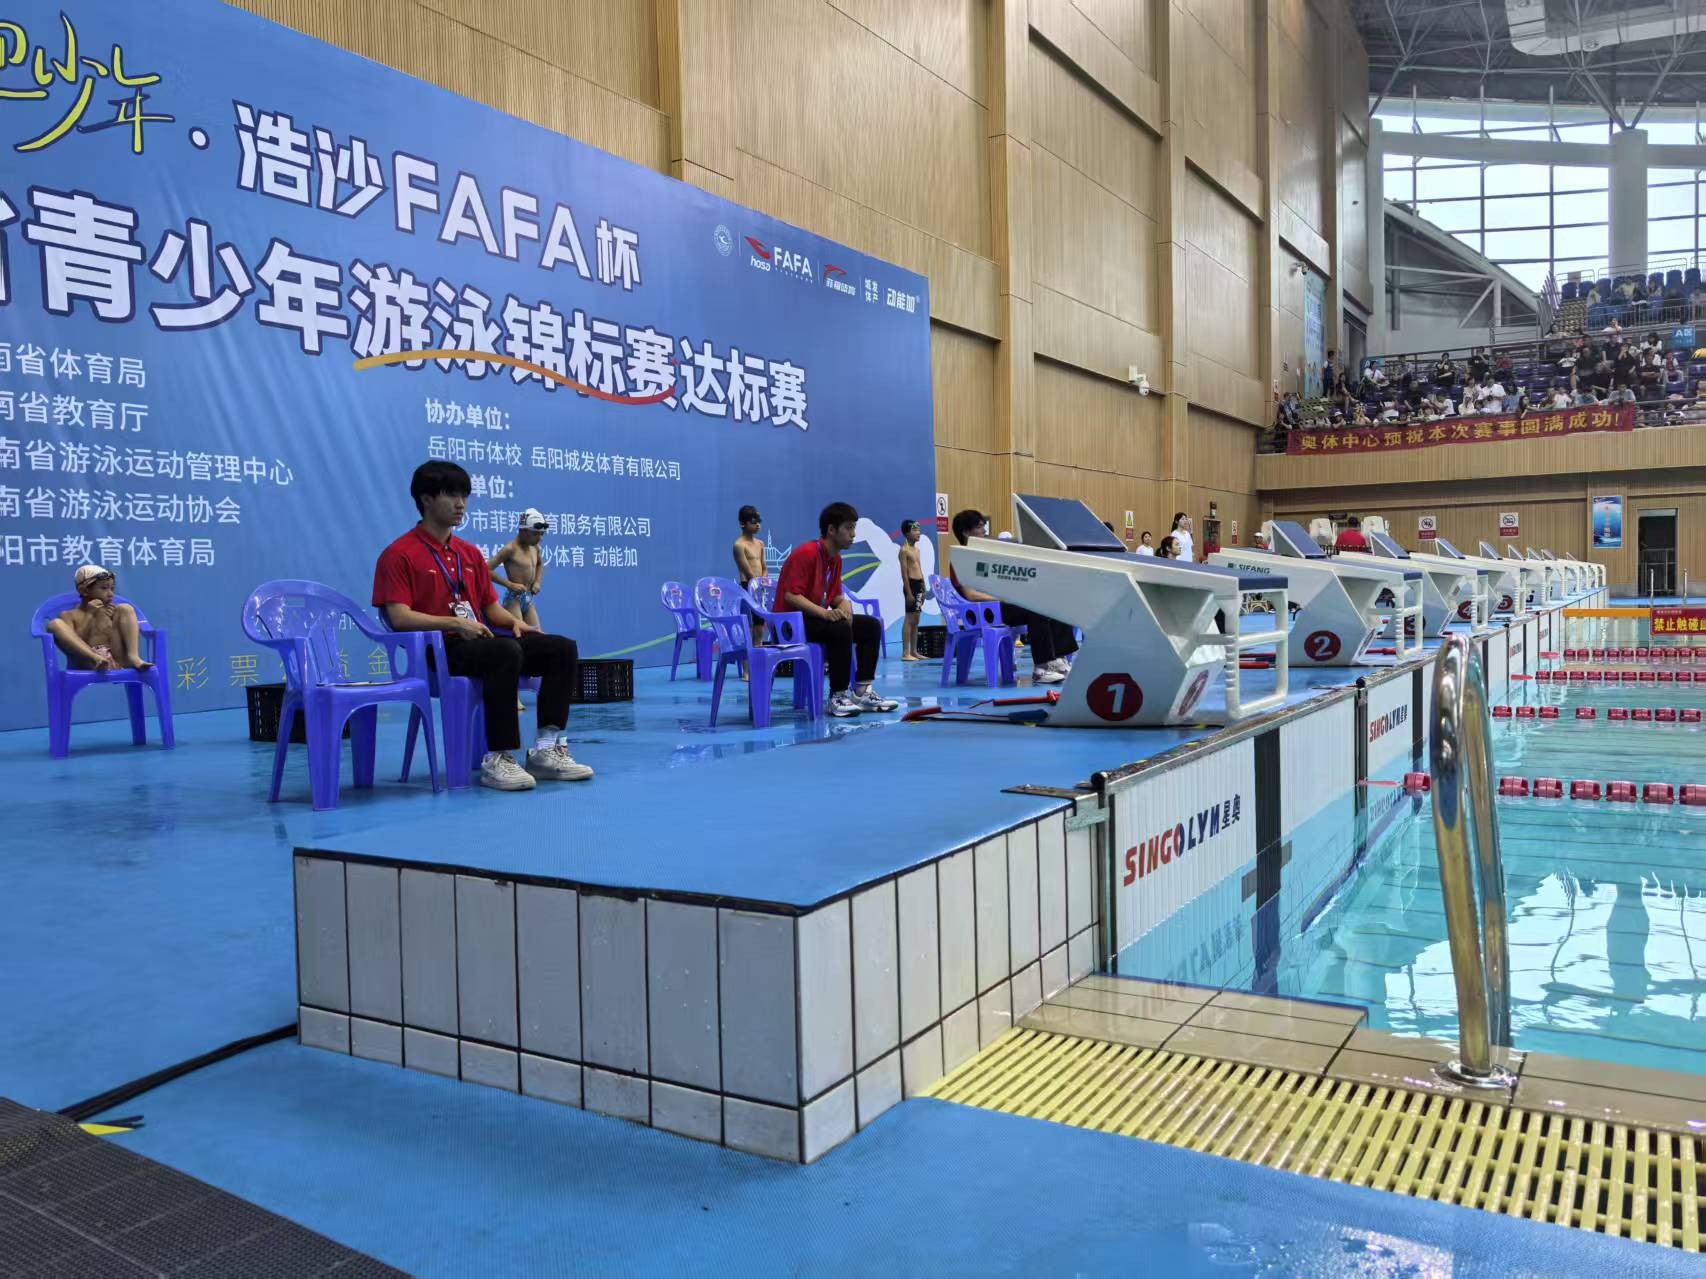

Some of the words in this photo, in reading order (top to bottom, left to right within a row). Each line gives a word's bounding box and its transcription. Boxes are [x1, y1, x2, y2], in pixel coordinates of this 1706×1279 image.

[750, 255, 771, 272] hosa
[773, 246, 813, 277] FAFA
[0, 185, 809, 432] 青少年游泳锦标赛达标赛
[0, 436, 294, 486] 南省游泳运动管理中心
[427, 436, 522, 467] 岳阳市体校
[530, 446, 681, 480] 岳阳城发体育有限公司
[0, 484, 241, 525] 南省游泳运动协会
[451, 508, 651, 537] 市菲翔育服务有限公司
[541, 546, 585, 568] 沙体育
[593, 546, 638, 568] 动能加
[991, 563, 1037, 578] SIFANG
[1239, 564, 1271, 574] SIFANG
[1313, 636, 1334, 657] 2
[1107, 684, 1128, 714] 1
[1123, 803, 1220, 888] SINGOLYM
